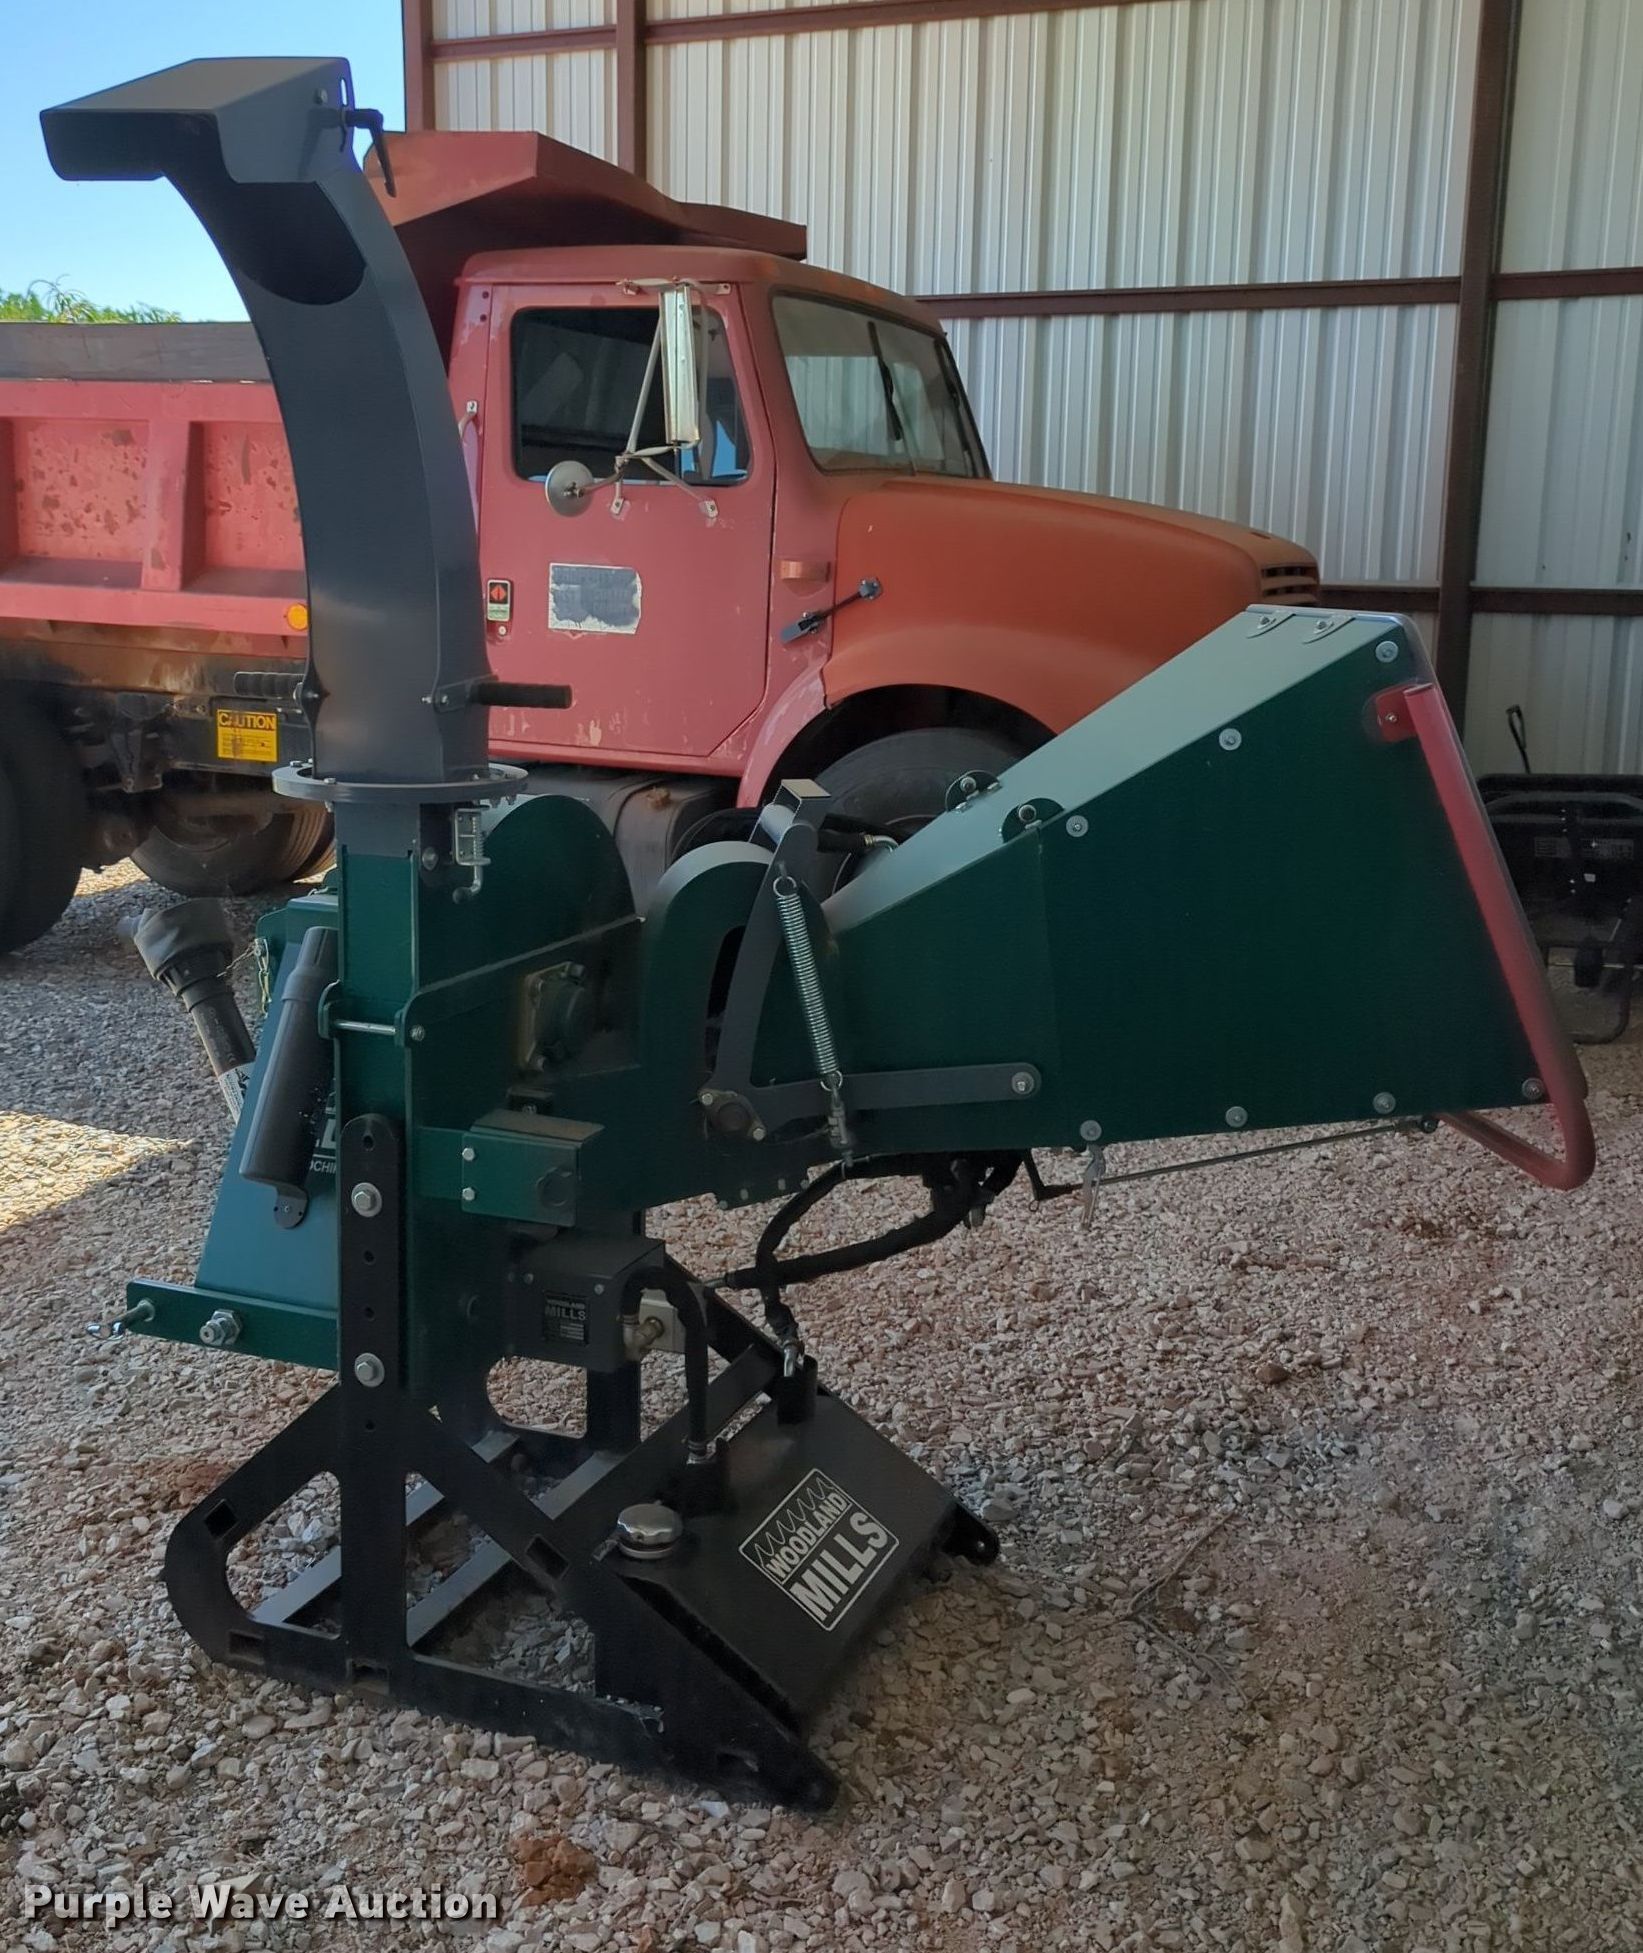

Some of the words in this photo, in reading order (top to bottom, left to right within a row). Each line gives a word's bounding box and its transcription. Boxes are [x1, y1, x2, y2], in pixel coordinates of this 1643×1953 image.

[219, 712, 275, 730] CAUTION
[545, 1305, 586, 1320] MILLS
[766, 1492, 848, 1579] WOODLAND
[789, 1512, 888, 1621] MILLS
